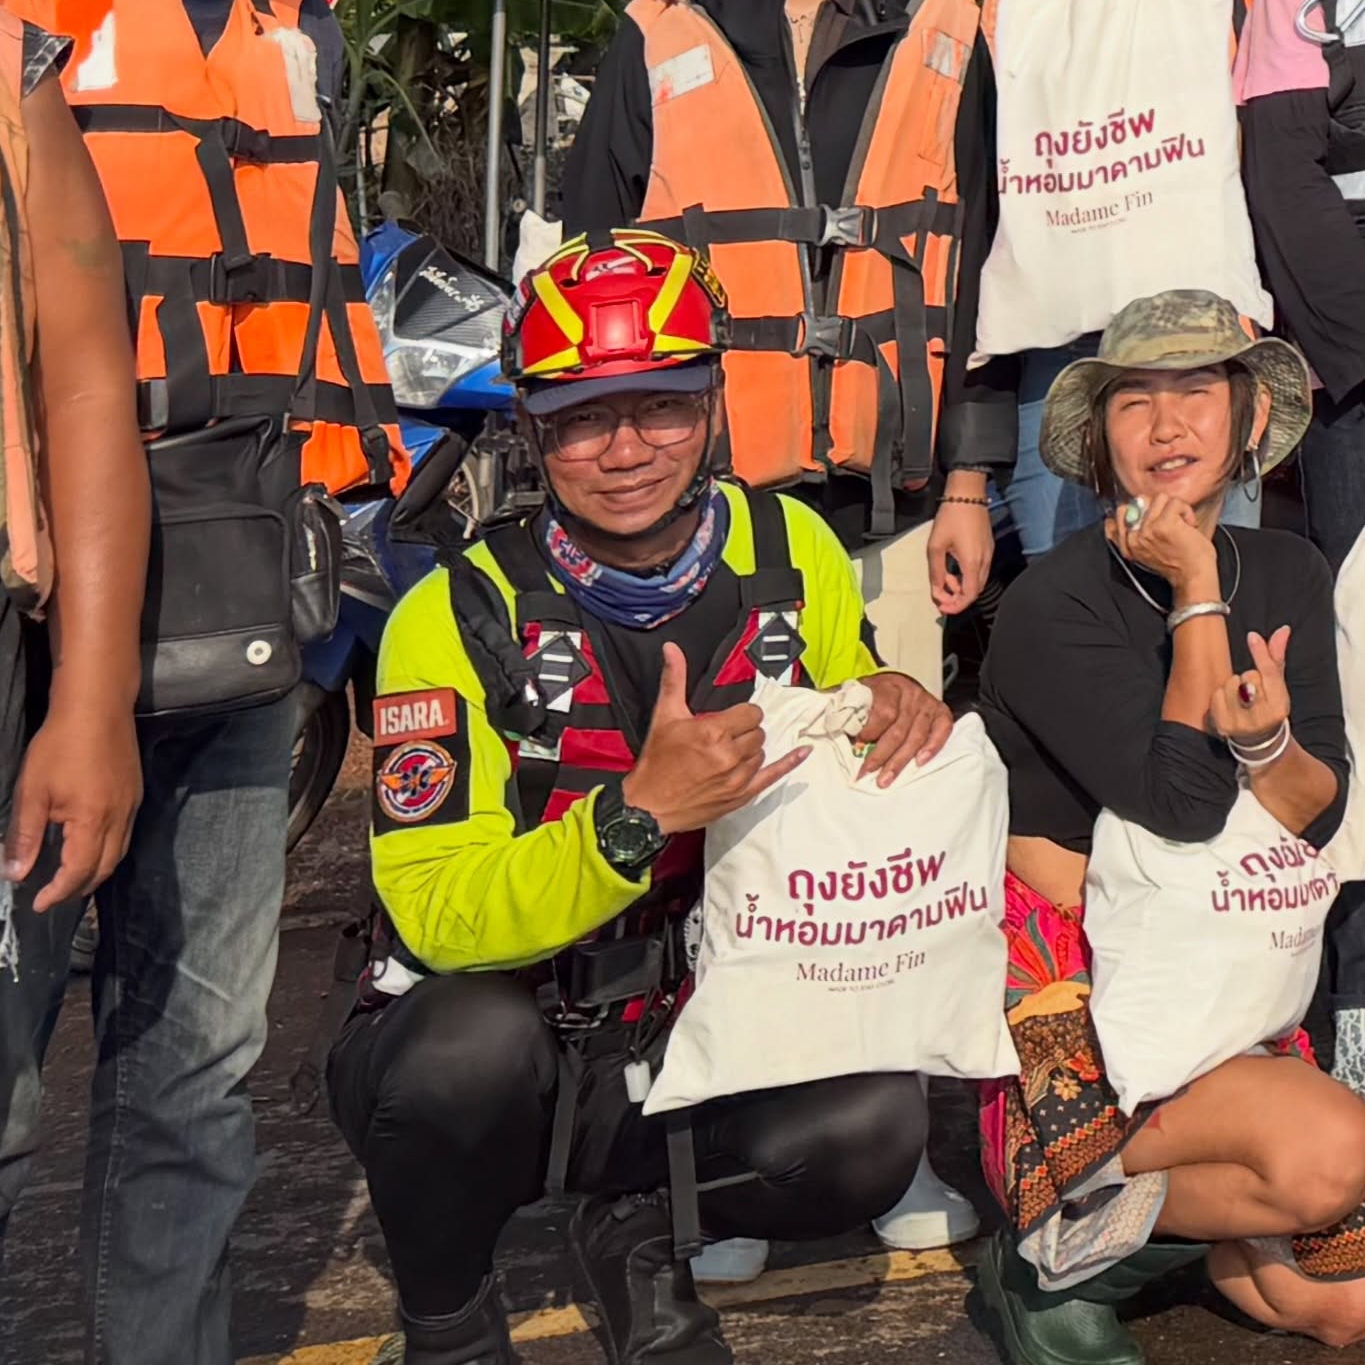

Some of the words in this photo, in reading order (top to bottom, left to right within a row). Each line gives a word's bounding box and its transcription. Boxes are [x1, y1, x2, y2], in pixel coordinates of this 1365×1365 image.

[1034, 107, 1155, 169] ถุงยังชีพ
[1045, 203, 1119, 227] Madame
[1124, 190, 1154, 212] Fin
[380, 699, 445, 736] ISARA
[788, 847, 947, 916] ถุงยังชีพ
[735, 881, 989, 947] น้ำหอมมาดามฟิน
[796, 960, 889, 983] Madame
[895, 949, 927, 974] Fin
